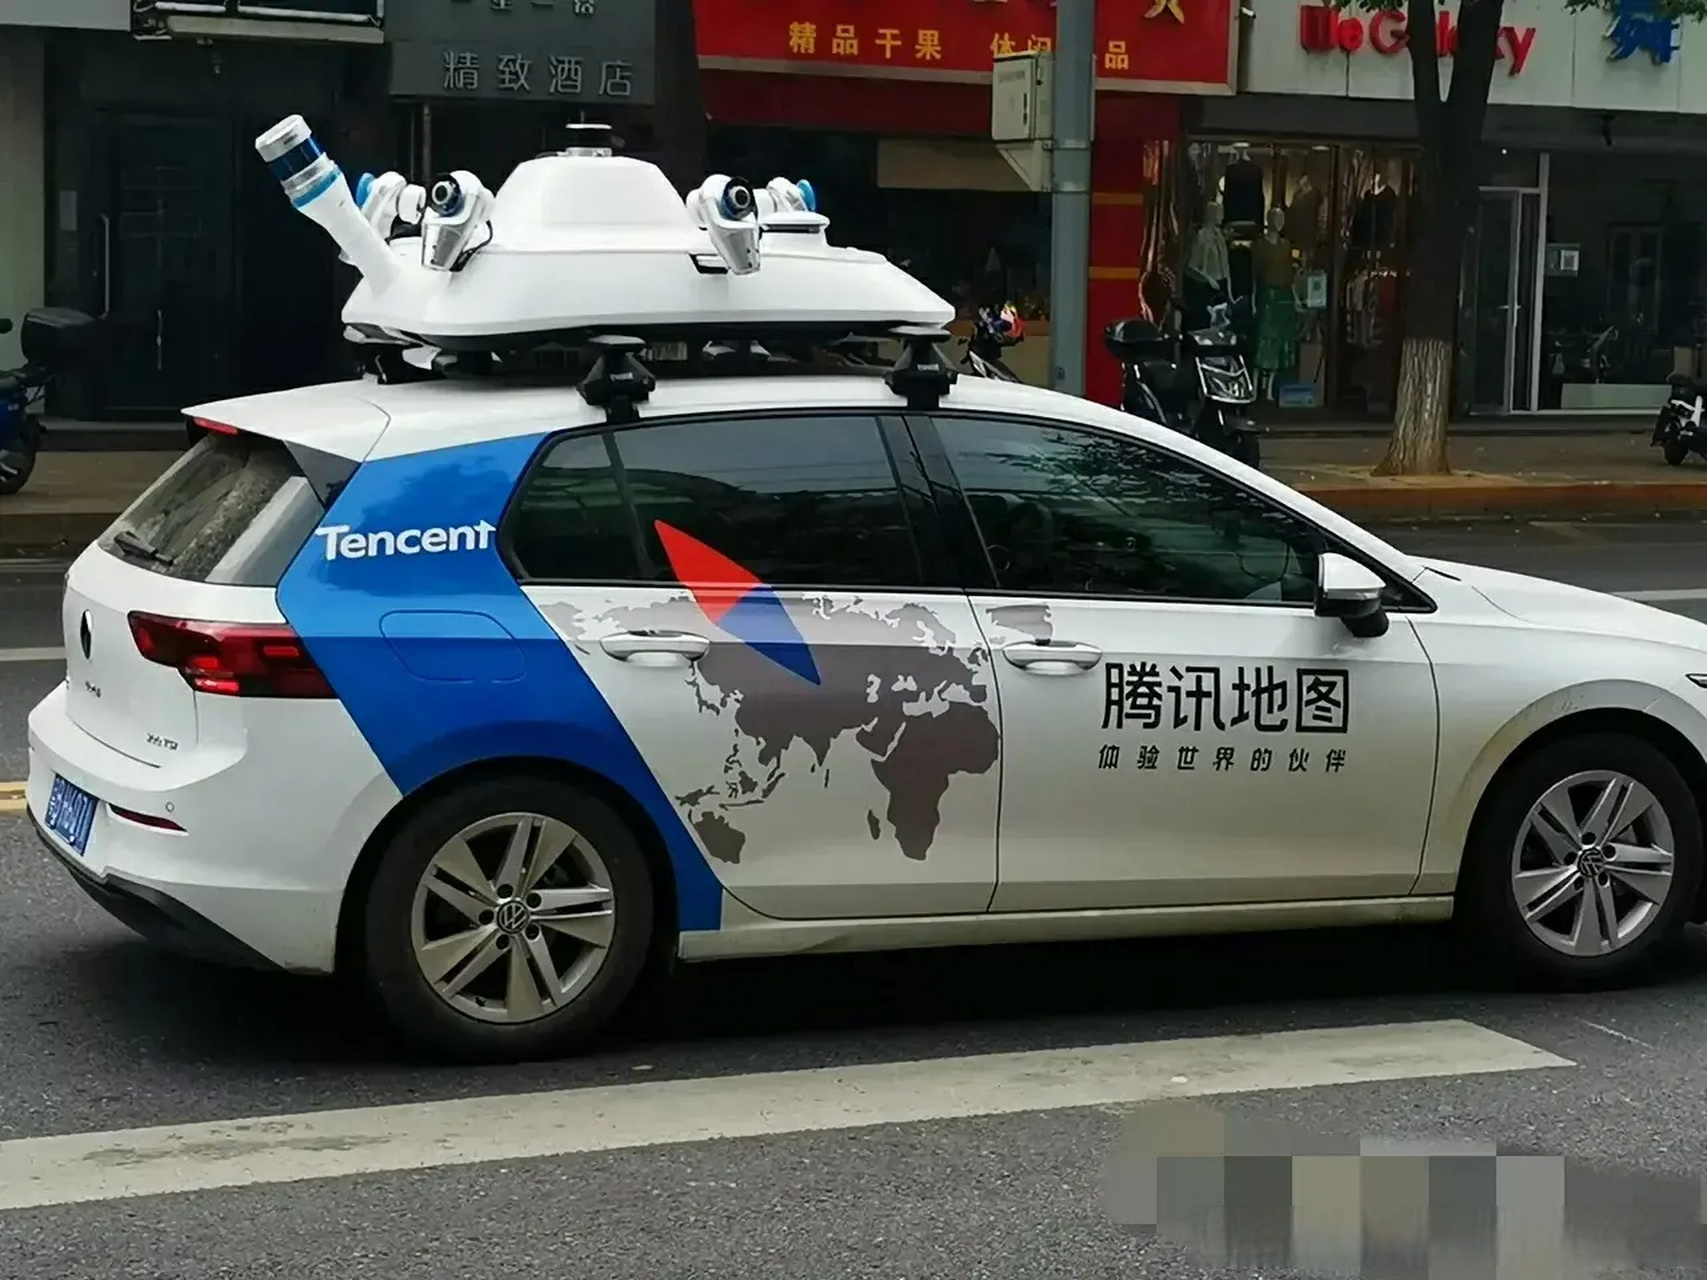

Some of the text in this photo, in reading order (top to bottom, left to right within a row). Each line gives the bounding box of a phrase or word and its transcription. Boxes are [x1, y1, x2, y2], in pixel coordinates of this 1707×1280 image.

[788, 20, 1130, 70] 精品干果 休闲品
[443, 51, 633, 97] 精致酒店
[314, 519, 497, 561] Tencent
[1101, 661, 1350, 734] 腾讯地图
[1098, 744, 1347, 773] 体验世界的伙伴
